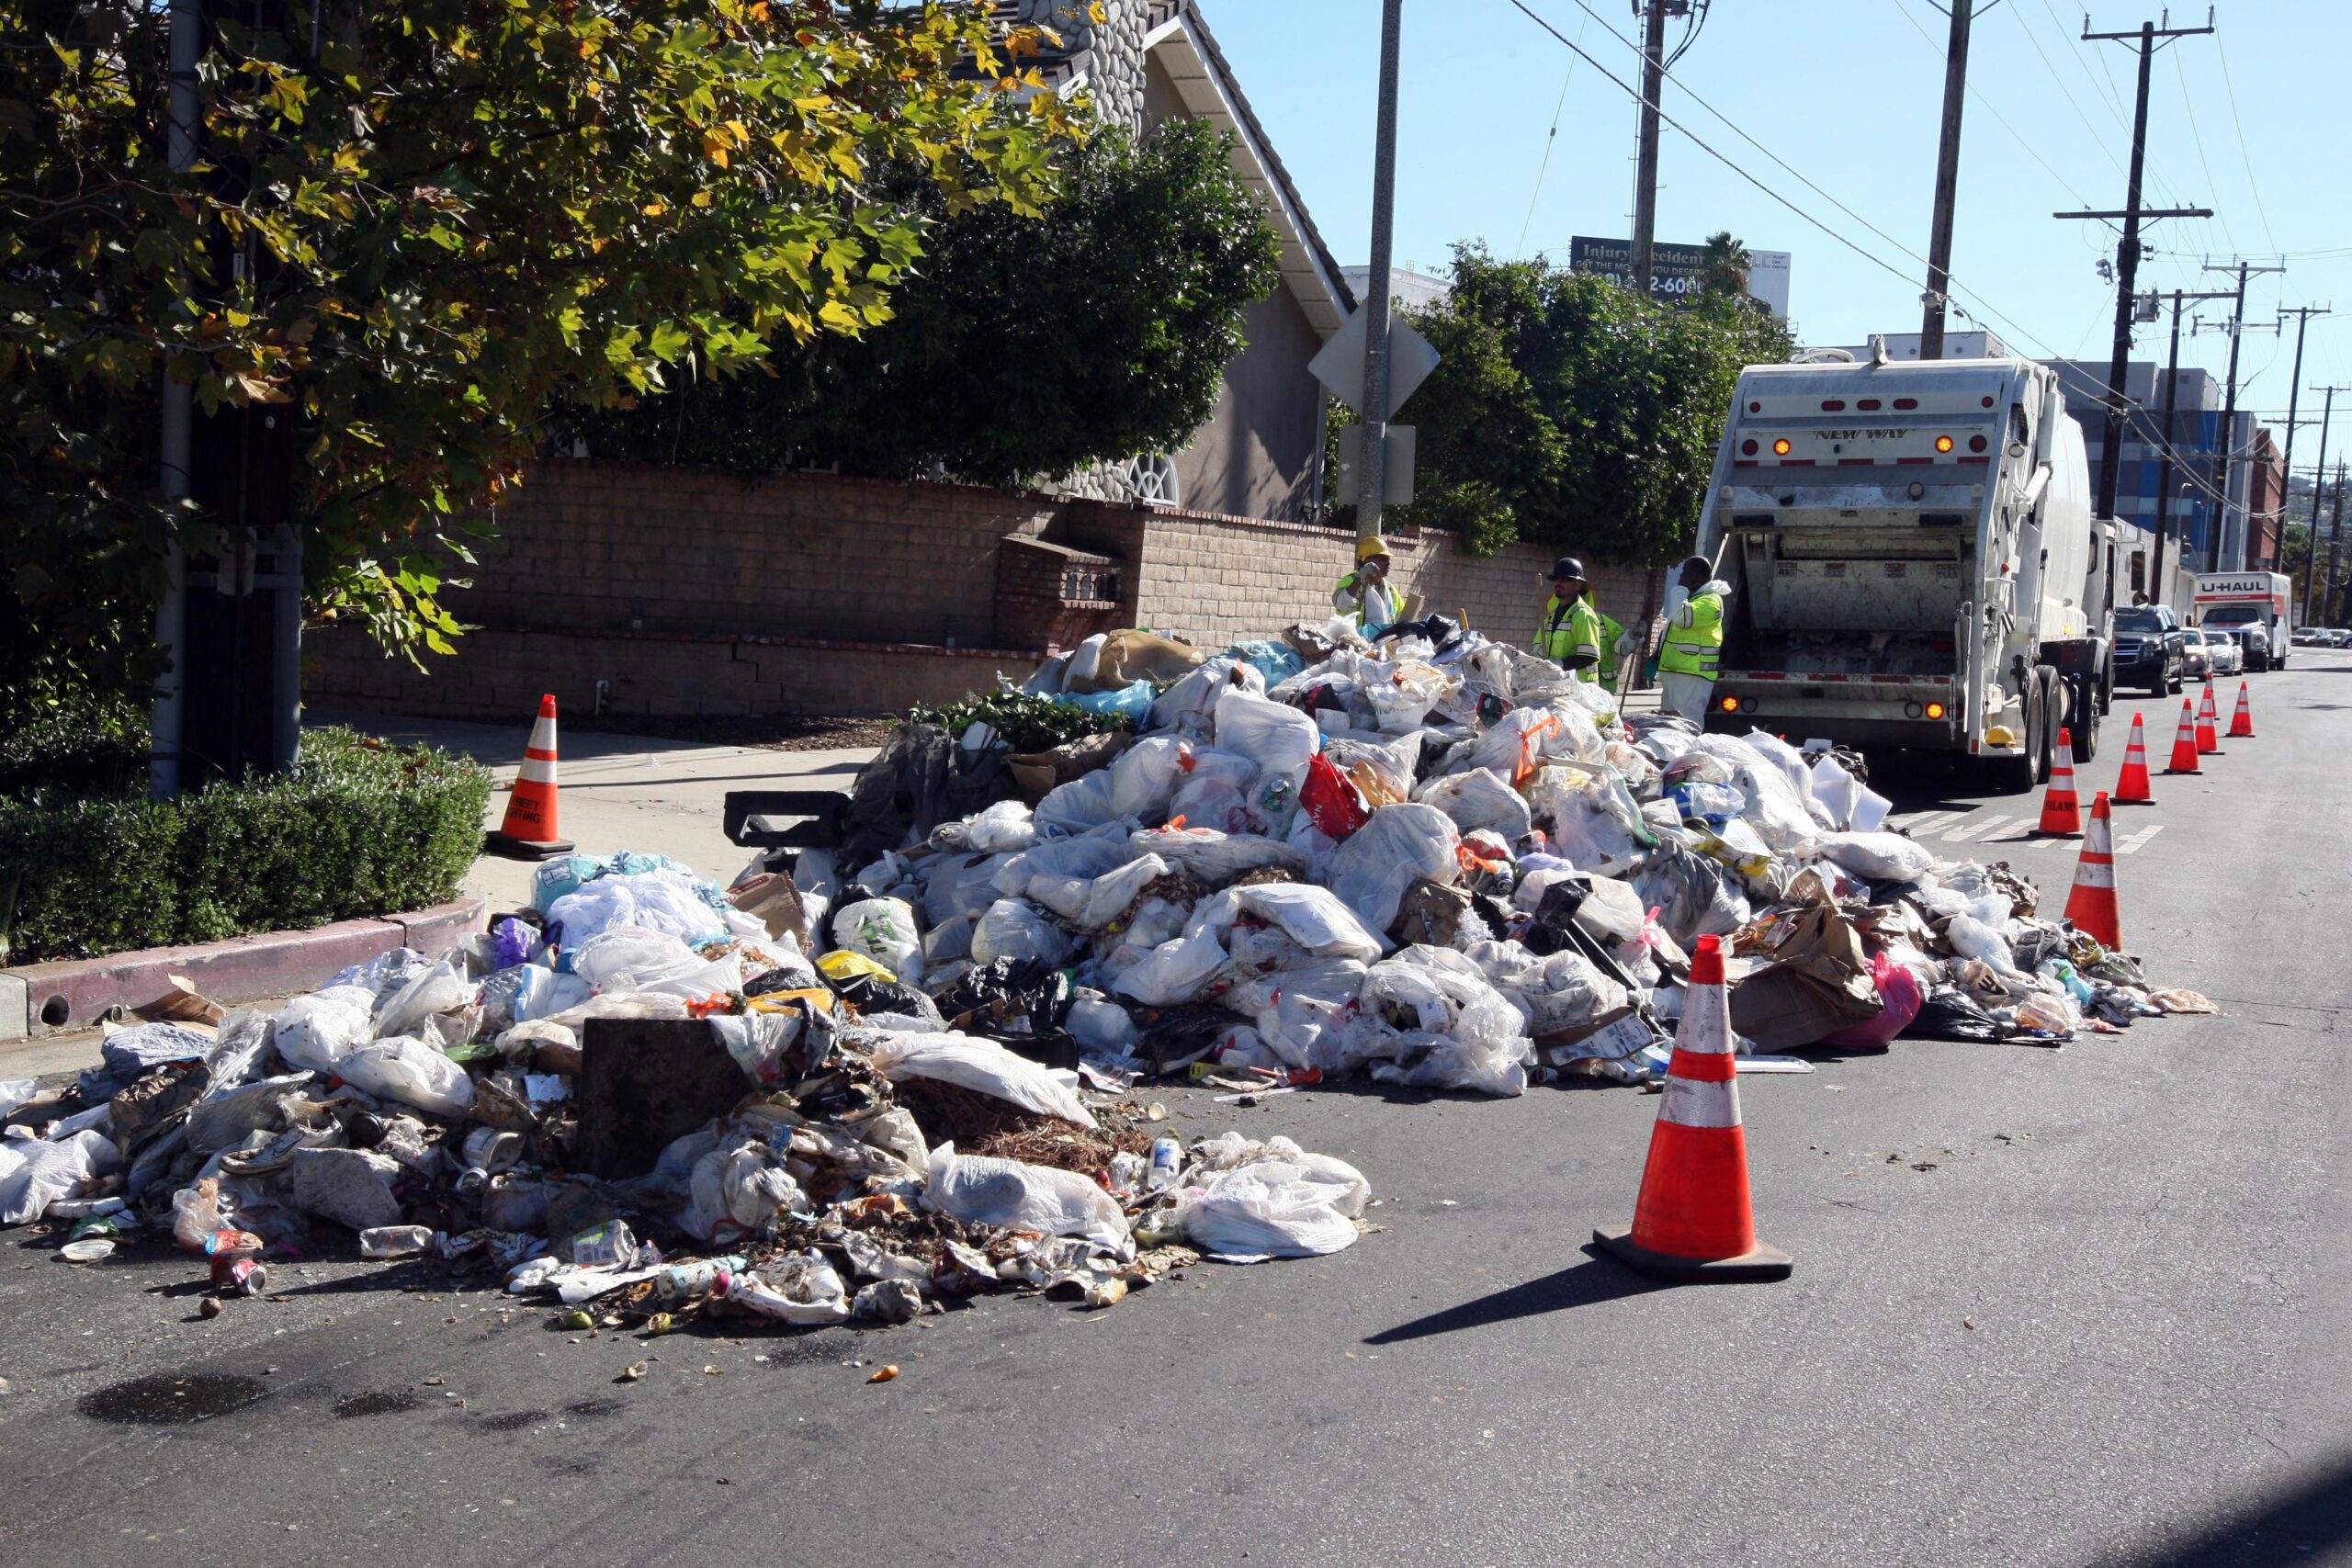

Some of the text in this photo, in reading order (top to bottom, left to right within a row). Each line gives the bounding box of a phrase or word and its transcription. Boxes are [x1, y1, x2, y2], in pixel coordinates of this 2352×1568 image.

[1584, 243, 1706, 265] Injury ccident
[1595, 261, 1612, 270] THE
[1815, 428, 1909, 440] NEW WAY
